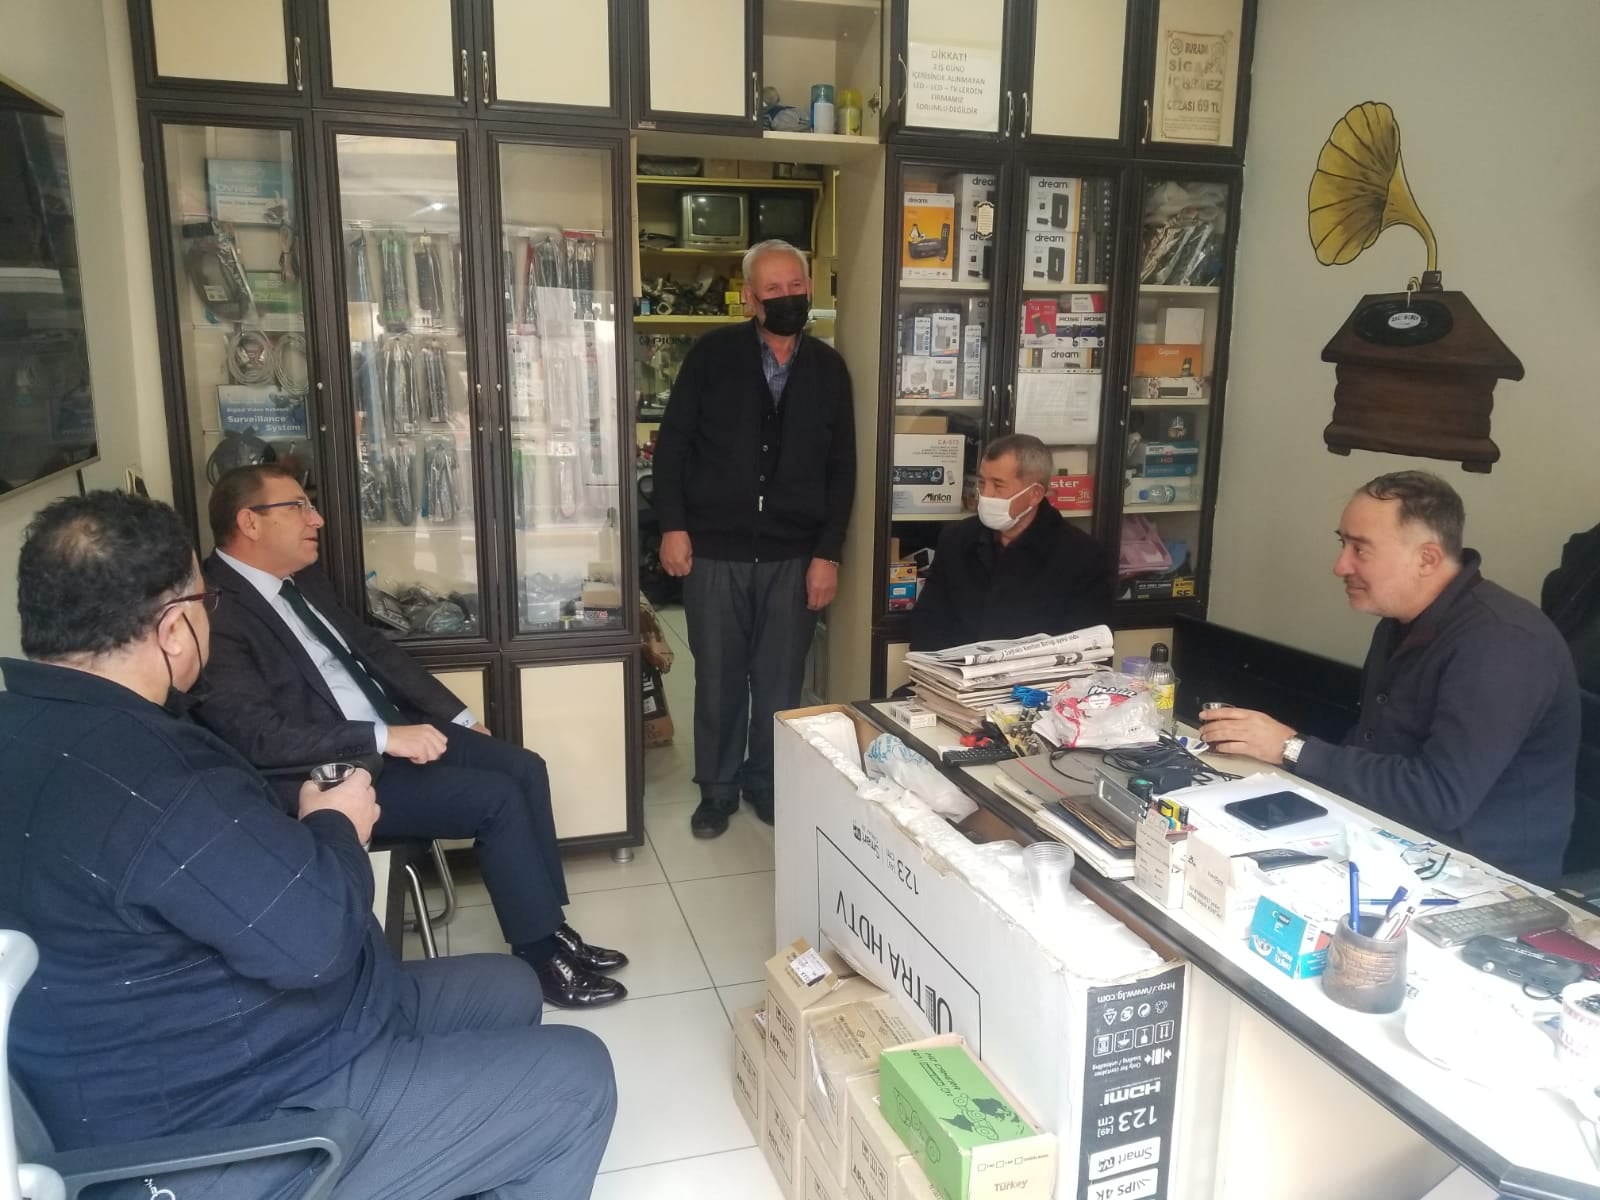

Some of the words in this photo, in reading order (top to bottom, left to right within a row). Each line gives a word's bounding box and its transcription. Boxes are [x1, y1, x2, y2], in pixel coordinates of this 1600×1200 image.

[931, 49, 967, 62] DİKKAT!
[946, 75, 985, 85] ALINMAYAN
[1167, 100, 1195, 112] CEZASI
[1211, 102, 1220, 113] TL
[1038, 179, 1068, 189] dream
[1035, 233, 1064, 243] dream
[1050, 350, 1079, 359] dream
[227, 416, 287, 424] Surveillance
[265, 424, 301, 433] System
[897, 860, 919, 895] 123
[836, 890, 883, 964] HDTV
[888, 942, 953, 1035] ULTRA
[1097, 982, 1176, 1003] http://www.lg.com
[1129, 1061, 1141, 1069] Only
[1103, 1081, 1161, 1106] HDMI
[1097, 1115, 1115, 1127] cm
[1118, 1105, 1158, 1133] 123
[1097, 1125, 1114, 1138] [49]
[1118, 1147, 1153, 1164] Smart
[1095, 1188, 1114, 1200] 4K
[1117, 1181, 1137, 1196] IPS
